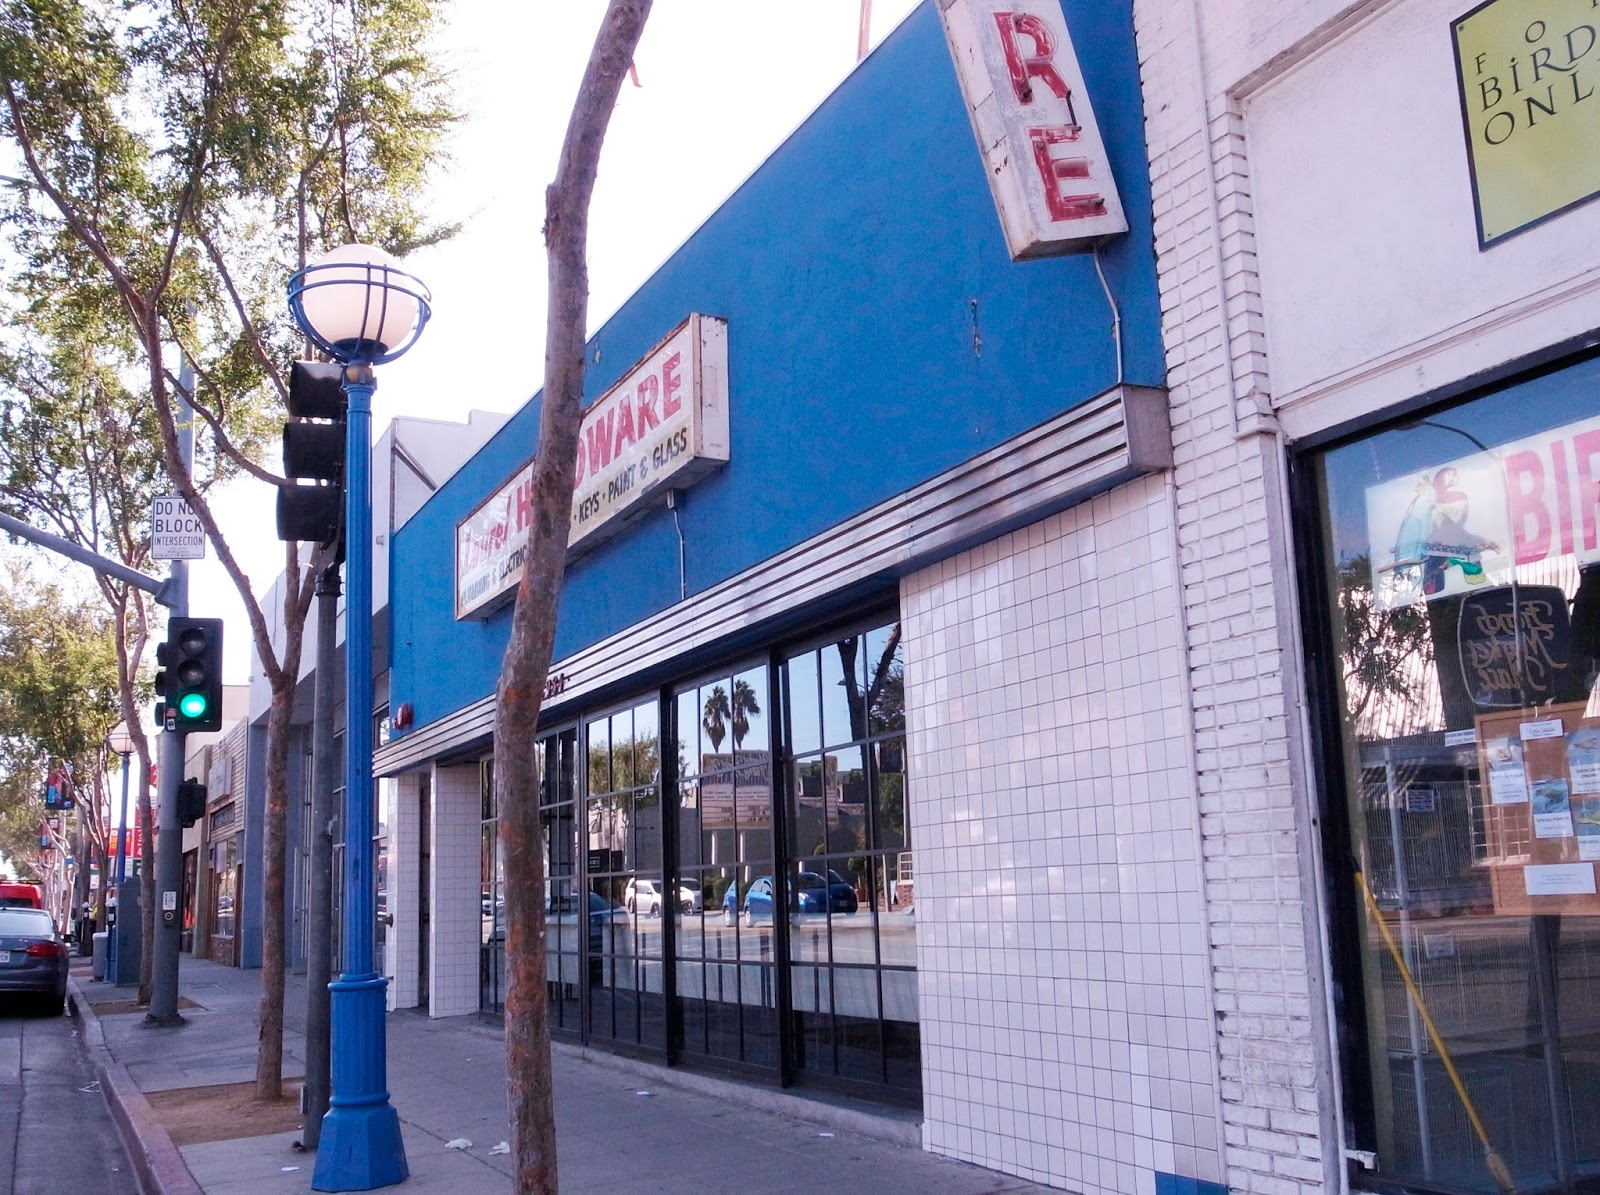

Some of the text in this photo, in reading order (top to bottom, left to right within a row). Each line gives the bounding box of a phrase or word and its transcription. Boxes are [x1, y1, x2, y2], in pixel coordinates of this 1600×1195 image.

[992, 11, 1109, 222] RE
[1484, 57, 1600, 146] ONL
[579, 490, 600, 524] KEYS
[608, 463, 637, 504] PAINT
[652, 426, 688, 471] GLASS
[155, 519, 203, 533] BLOCK
[156, 501, 196, 516] DO NO
[154, 536, 204, 546] INTERSECTION
